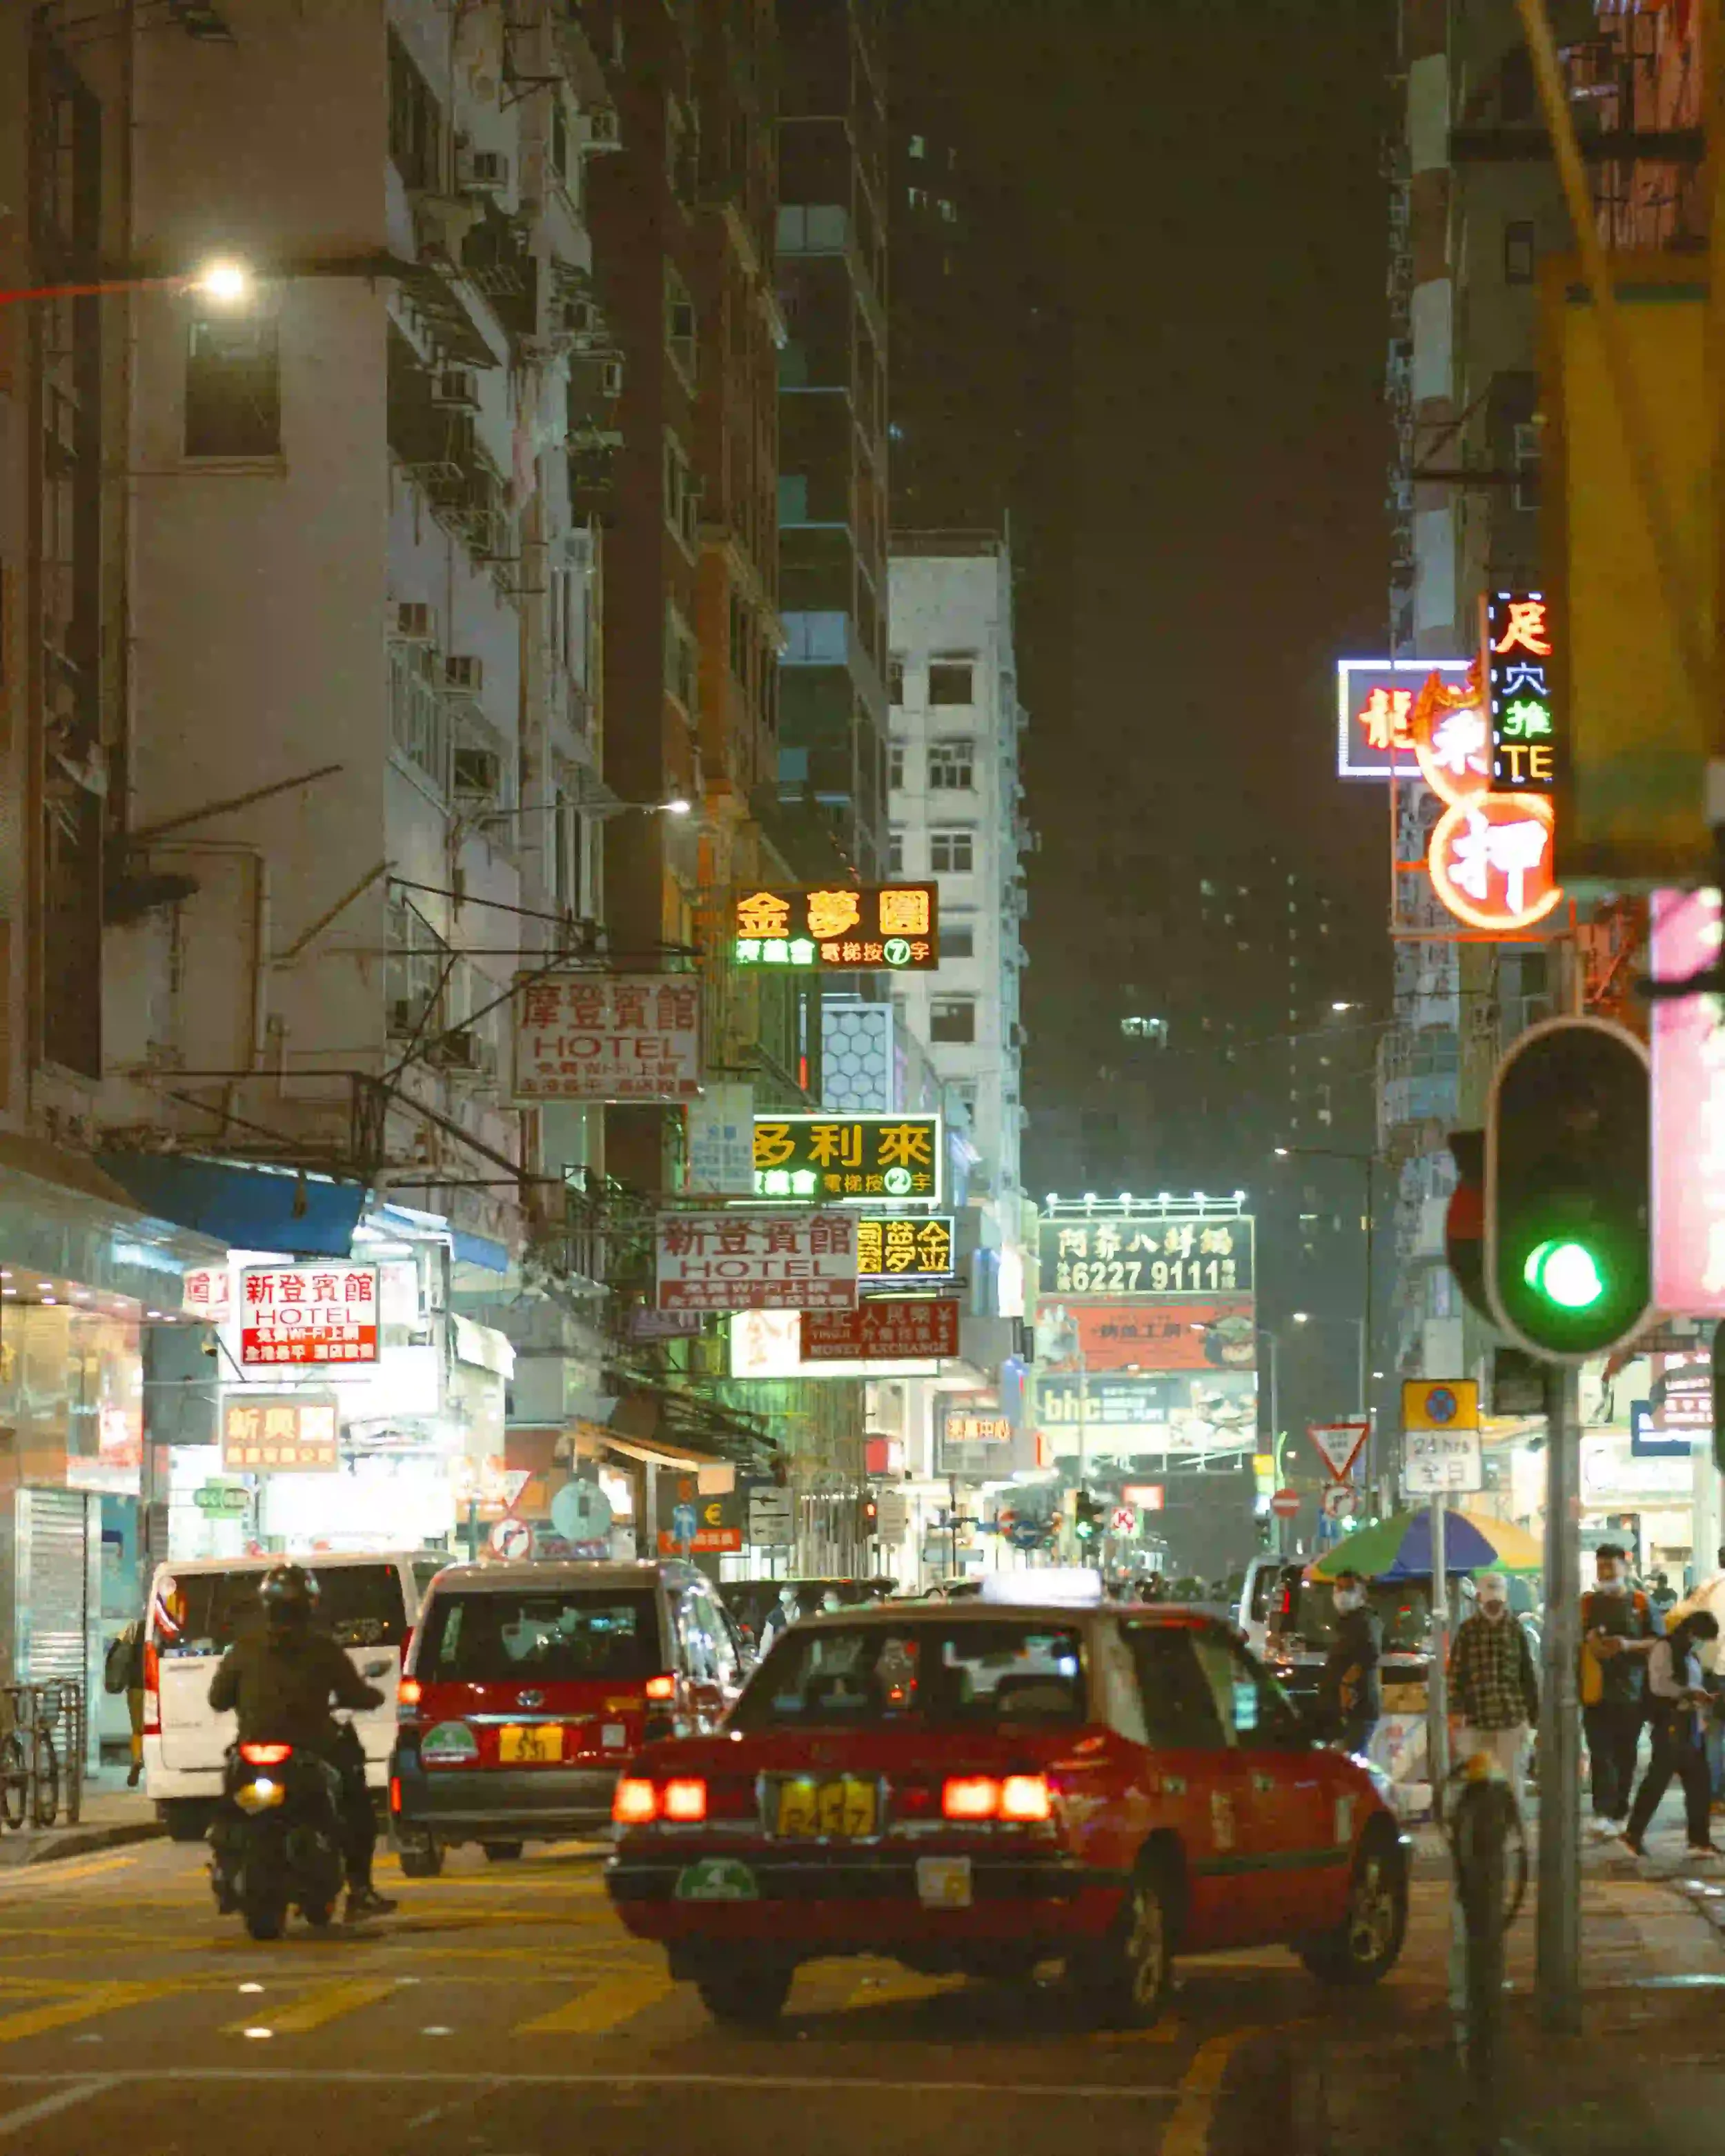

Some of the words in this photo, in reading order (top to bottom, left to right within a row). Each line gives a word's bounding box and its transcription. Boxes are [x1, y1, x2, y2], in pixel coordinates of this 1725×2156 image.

[1500, 745, 1553, 778] TE
[534, 1036, 686, 1058] HOTEL
[753, 1124, 931, 1167] 多利來
[664, 1215, 851, 1256] 新登賓館
[680, 1260, 836, 1277] HOTEL
[1073, 1261, 1141, 1291] 6227
[1150, 1260, 1218, 1290] 9111
[246, 1273, 373, 1304] 新登賓館
[255, 1308, 361, 1325] HOTEL
[811, 1344, 861, 1355] MONEY
[869, 1342, 948, 1354] EXCHANGE
[1044, 1389, 1101, 1421] bhc
